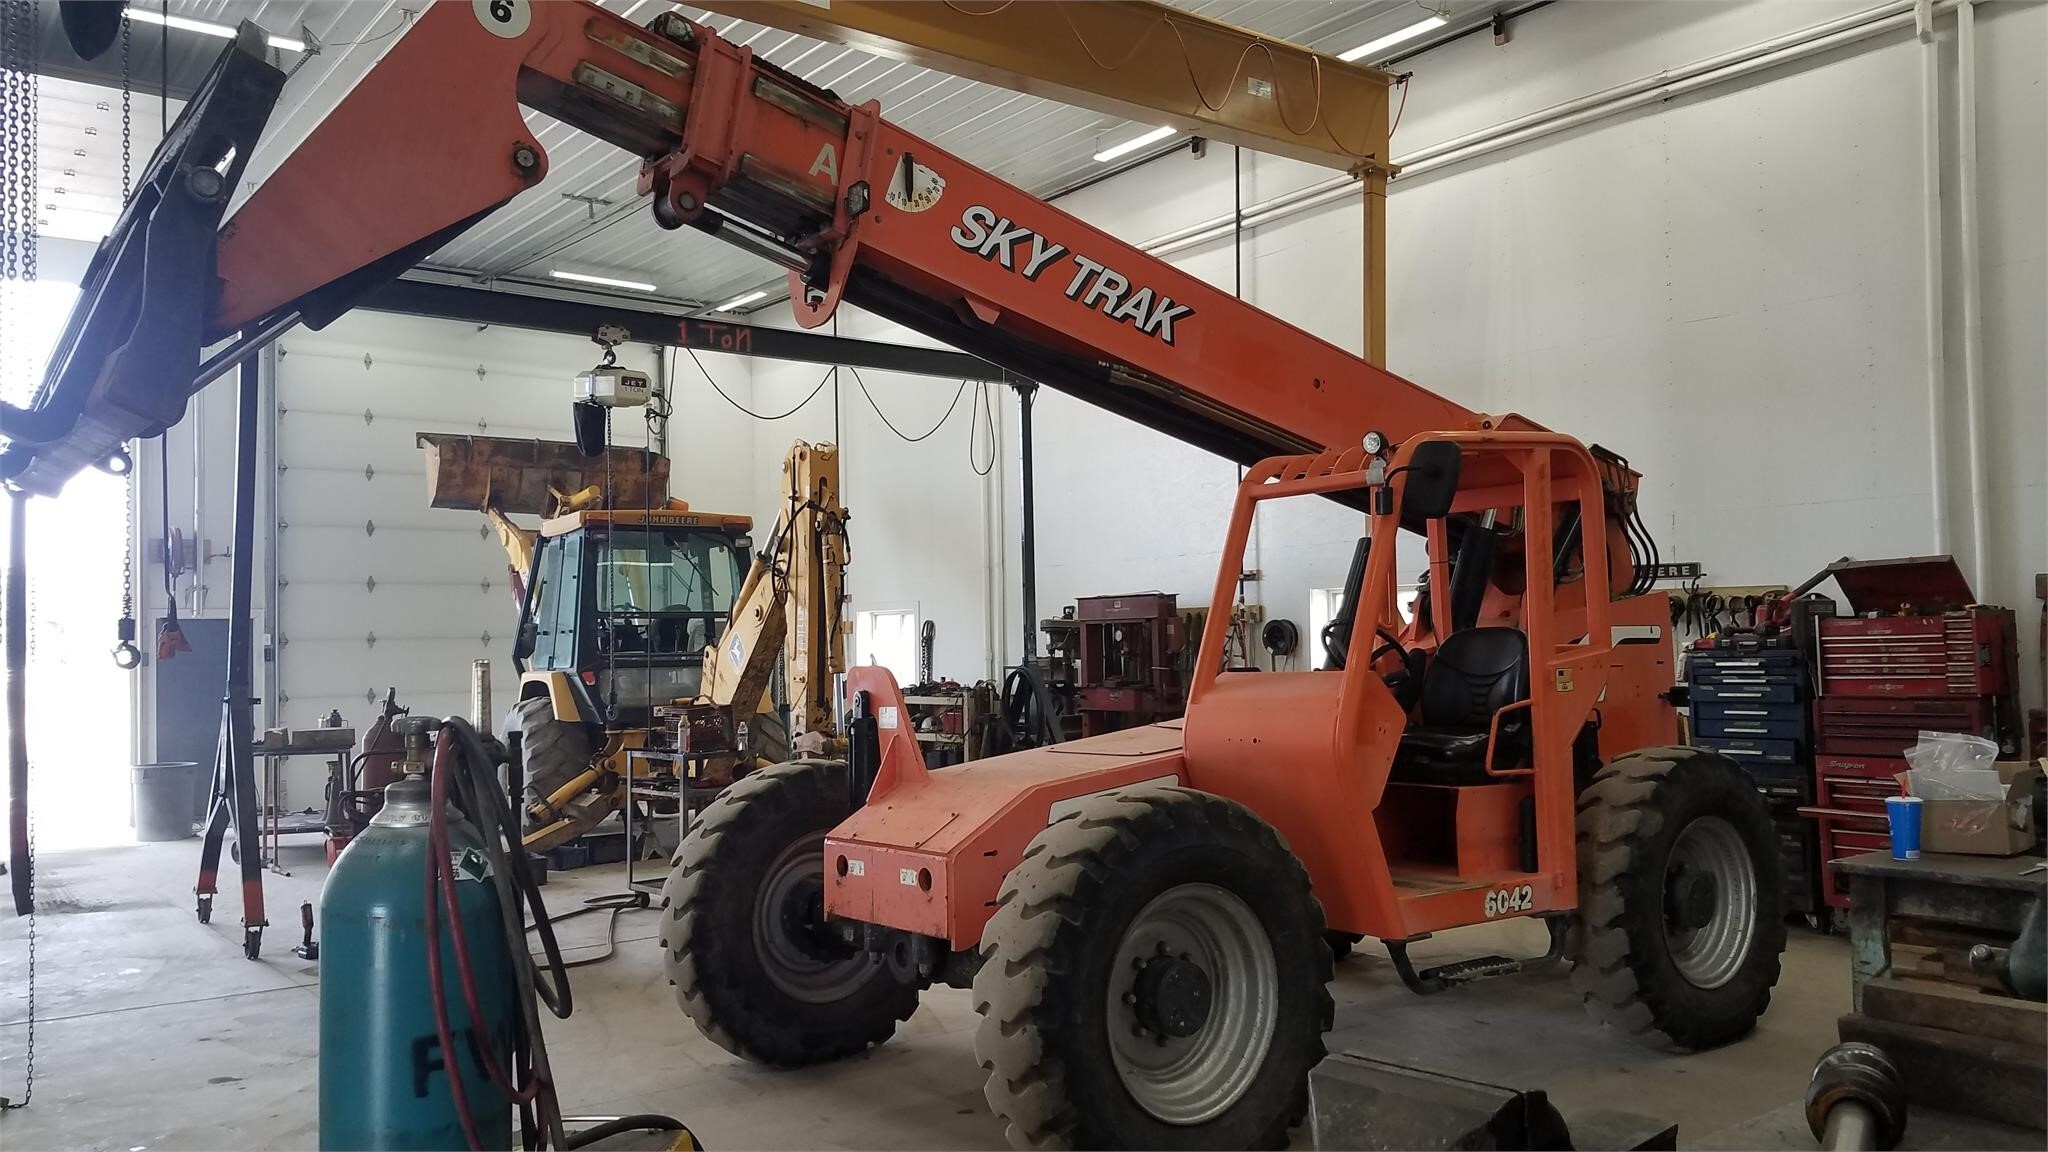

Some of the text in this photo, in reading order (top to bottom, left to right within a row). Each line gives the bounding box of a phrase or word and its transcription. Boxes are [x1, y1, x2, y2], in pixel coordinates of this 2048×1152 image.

[490, 0, 515, 23] 6
[808, 143, 839, 186] A
[951, 205, 1195, 347] SKY TRAK
[679, 320, 687, 346] 1
[668, 516, 699, 525] DEERE
[1484, 885, 1533, 918] 6042
